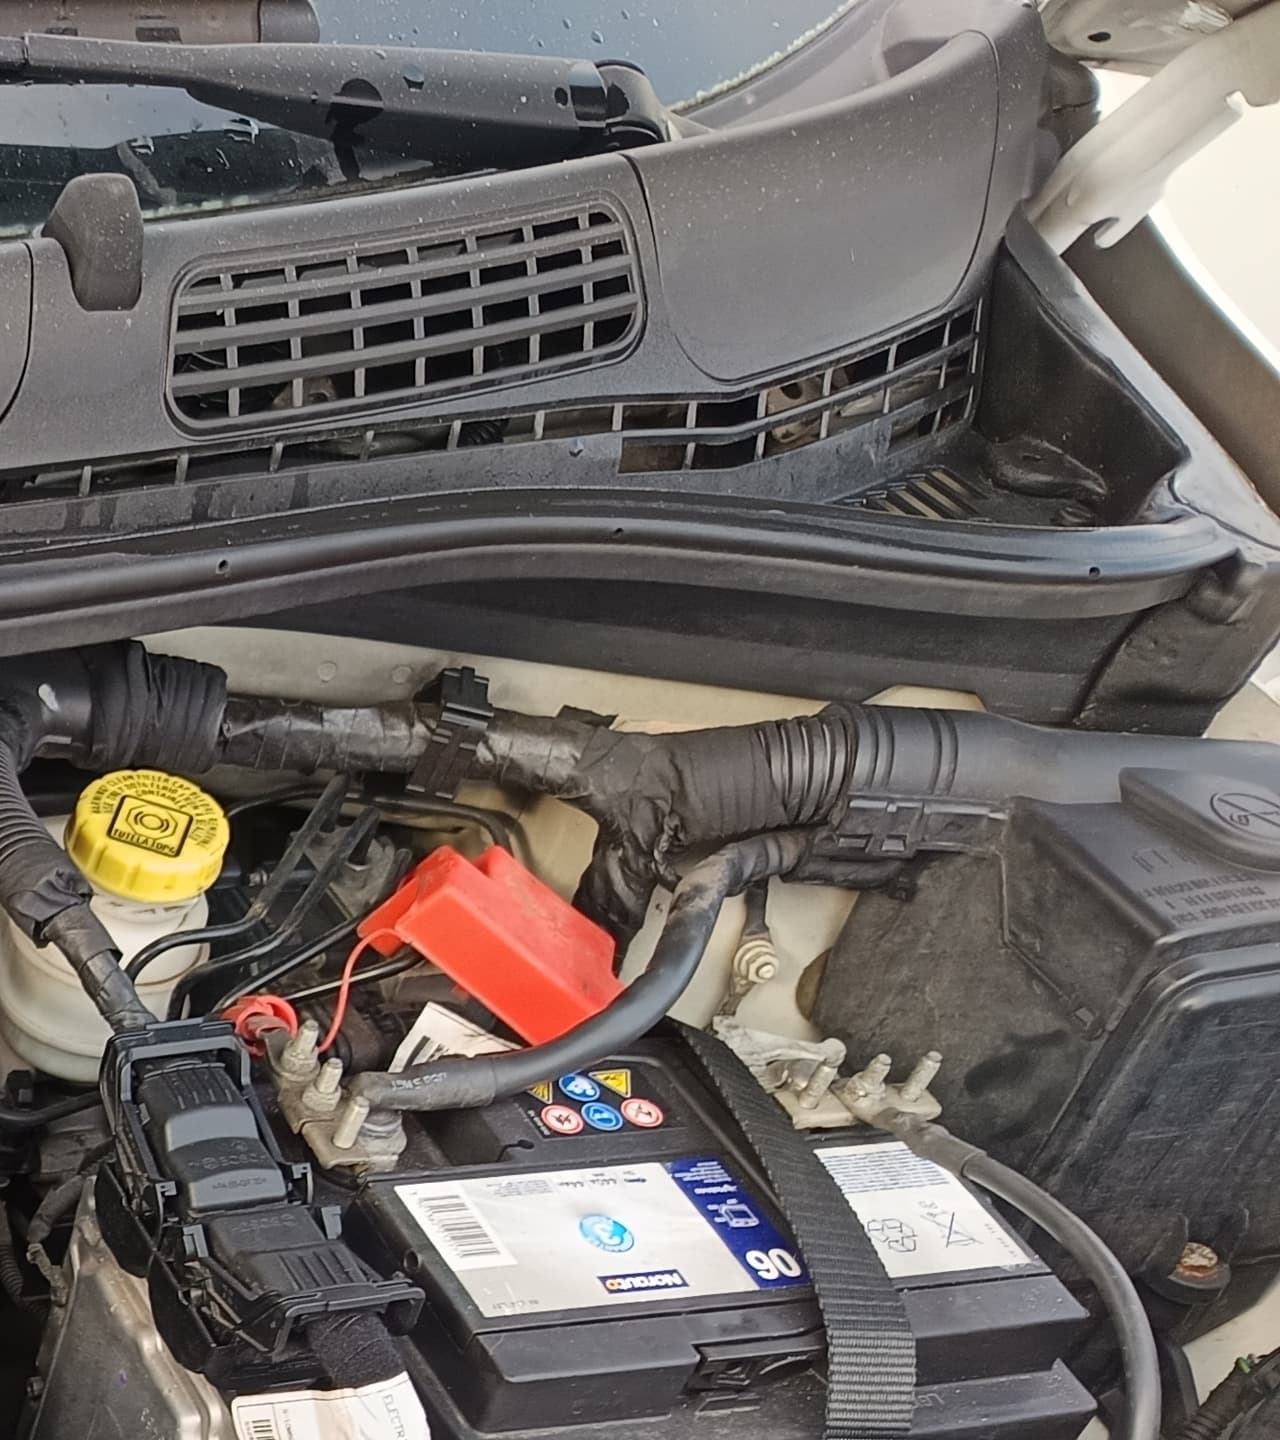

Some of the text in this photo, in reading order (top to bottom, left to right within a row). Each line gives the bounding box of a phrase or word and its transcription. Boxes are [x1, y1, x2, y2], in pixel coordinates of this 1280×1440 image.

[113, 828, 150, 847] TUTELA
[746, 1247, 802, 1280] 06
[606, 1272, 683, 1290] Norauto
